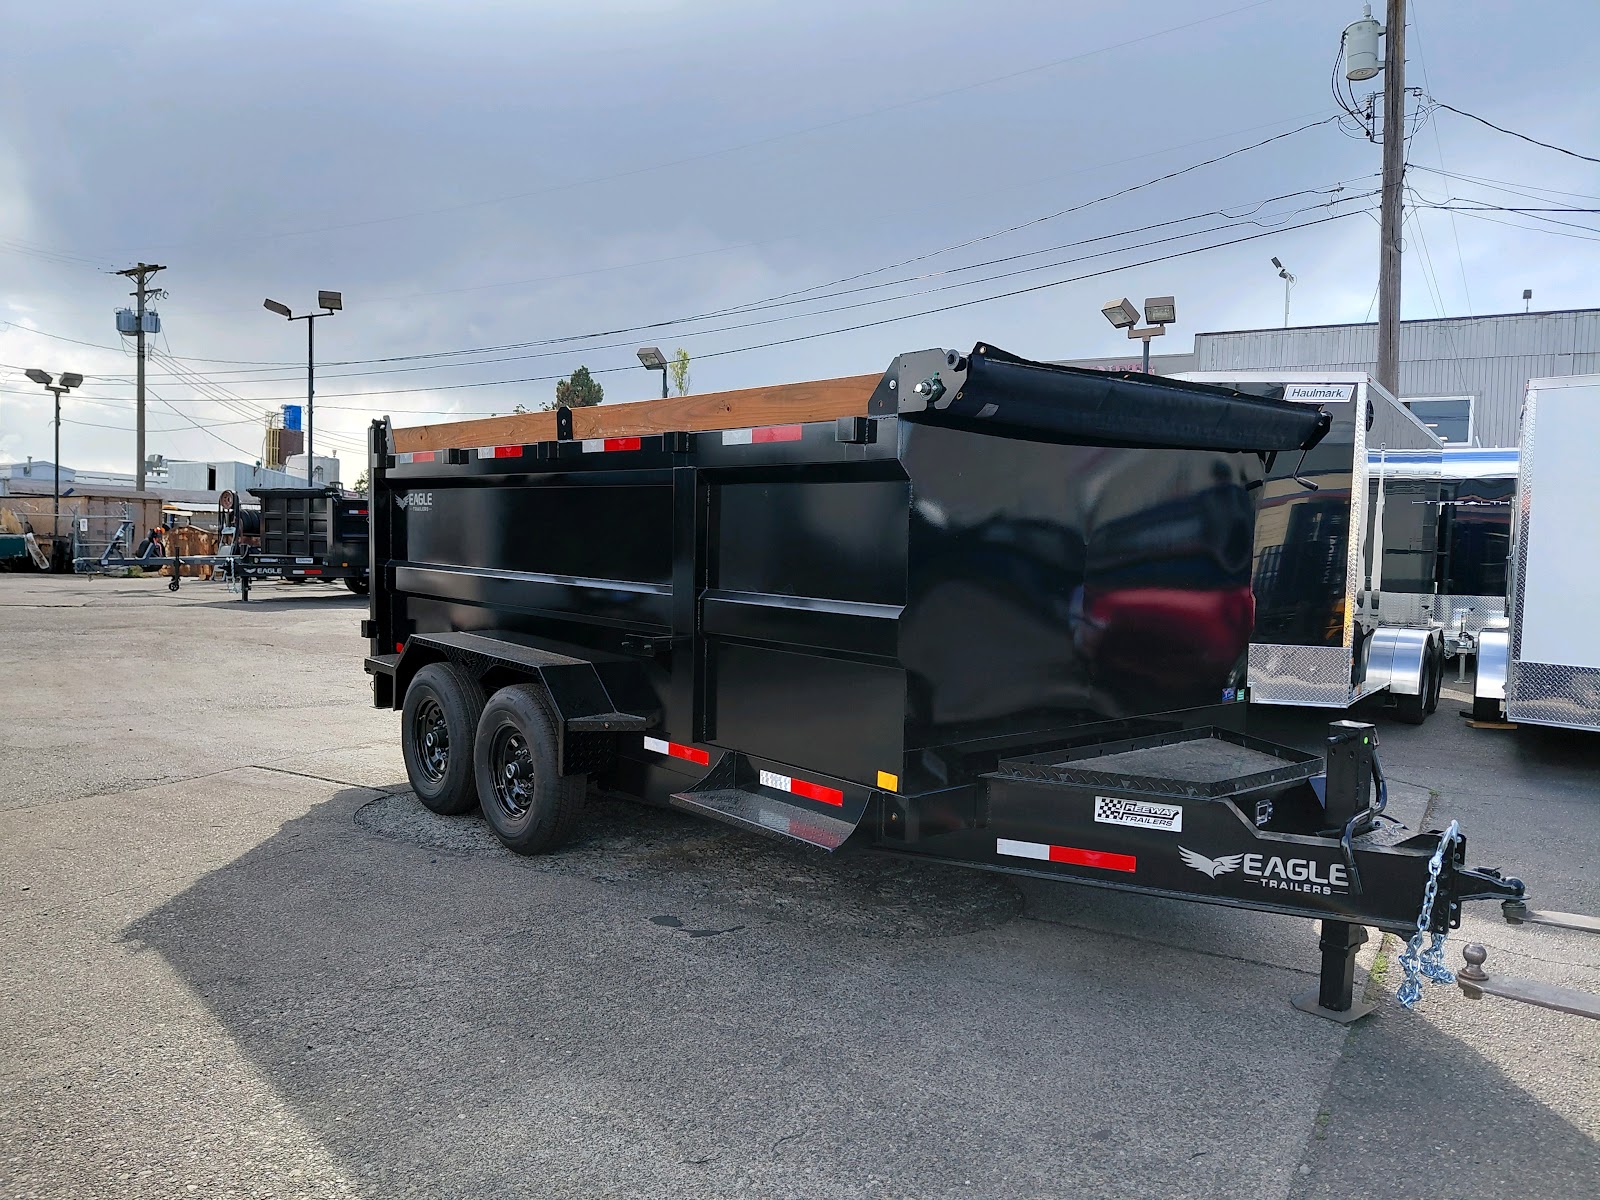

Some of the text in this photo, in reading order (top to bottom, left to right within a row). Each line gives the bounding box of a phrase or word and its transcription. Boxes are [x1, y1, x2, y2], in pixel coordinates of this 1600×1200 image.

[408, 492, 433, 506] EAGLE
[1124, 815, 1174, 827] TRAILERS
[1243, 853, 1349, 887] EAGLE
[1260, 878, 1332, 895] TRAILERS
